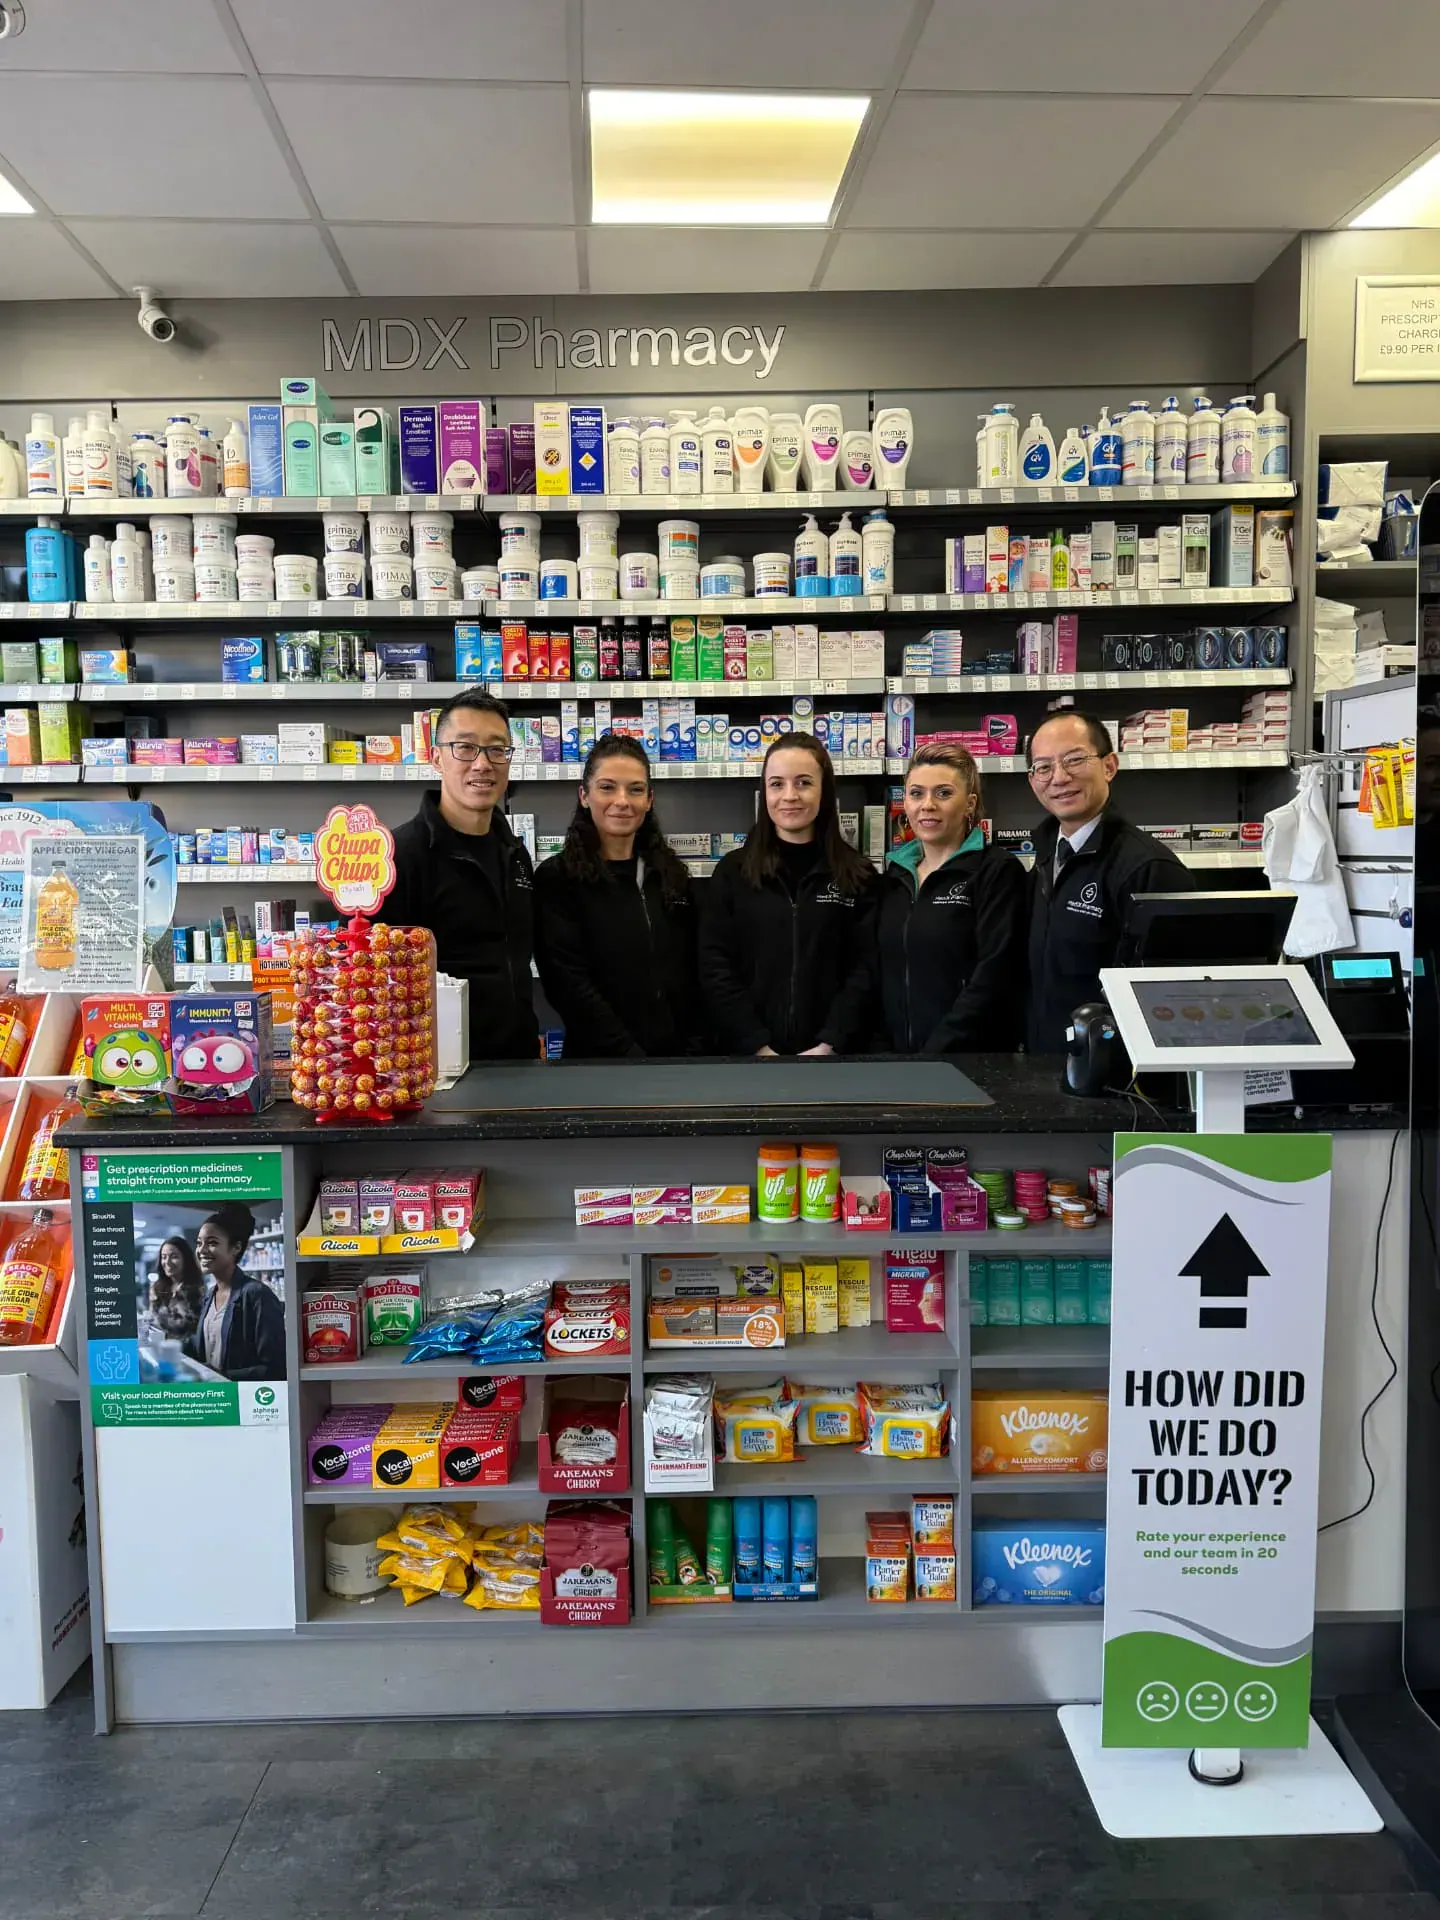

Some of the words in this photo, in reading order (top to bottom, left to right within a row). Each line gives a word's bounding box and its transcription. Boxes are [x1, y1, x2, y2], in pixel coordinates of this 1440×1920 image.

[1411, 299, 1436, 309] NHS
[321, 317, 471, 372] MDX
[489, 316, 787, 379] Pharmacy
[1411, 344, 1434, 353] PER
[223, 642, 254, 653] Nicotinell
[15, 811, 42, 829] 1912
[349, 821, 370, 833] STICK
[997, 830, 1031, 838] PARAMOL
[33, 846, 61, 855] APPLE
[64, 846, 91, 855] CIDER
[95, 846, 137, 855] VINEGAR
[327, 833, 382, 862] Chupa
[325, 857, 380, 883] Chups
[259, 960, 291, 970] HOTHANDS
[110, 1003, 136, 1011] MULTI
[189, 1008, 232, 1017] IMMUNITY
[104, 1012, 143, 1021] VITAMINS
[885, 1149, 924, 1160] ChapStick
[928, 1149, 966, 1160] ChapStick
[106, 1165, 126, 1174] Get
[128, 1165, 189, 1176] prescription
[191, 1164, 243, 1173] medicines
[106, 1175, 147, 1187] straight
[149, 1175, 174, 1184] from
[175, 1177, 198, 1186] your
[199, 1174, 253, 1185] pharmacy
[322, 1184, 354, 1194] Ricola
[361, 1184, 393, 1193] Ricola
[436, 1185, 469, 1195] Ricola
[397, 1190, 428, 1199] Ricola
[320, 1239, 359, 1250] Ricola
[401, 1234, 441, 1248] Ricola
[17, 1289, 39, 1299] CIDER
[373, 1285, 413, 1296] POTTER'S
[308, 1300, 350, 1312] POTTER'S
[752, 1320, 773, 1330] 18%
[551, 1328, 611, 1340] LOCKETS
[468, 1375, 519, 1397] Vocalzone
[1124, 1370, 1224, 1407] HOW
[1233, 1370, 1305, 1407] DID
[102, 1392, 120, 1400] Visit
[121, 1393, 140, 1401] your
[141, 1391, 161, 1399] local
[163, 1391, 205, 1399] Pharmacy
[206, 1390, 225, 1398] First
[1000, 1405, 1090, 1438] Kleenex
[1149, 1419, 1209, 1456] WE
[1219, 1419, 1277, 1457] DO
[318, 1444, 372, 1469] Vocalzone
[383, 1450, 435, 1473] Vocalzone
[451, 1445, 505, 1470] Vocalzone
[1011, 1457, 1043, 1465] ALLERGY
[650, 1462, 687, 1471] FISHERMAN'S
[687, 1462, 707, 1471] FRIEND
[566, 1478, 601, 1489] CHERRY
[1131, 1468, 1293, 1506] TODAY?
[920, 1510, 947, 1521] Barrier
[1136, 1531, 1170, 1542] Rate
[1173, 1533, 1206, 1545] your
[1208, 1532, 1287, 1545] experience
[1003, 1537, 1092, 1570] Kleenex
[1143, 1548, 1172, 1559] and
[1174, 1549, 1199, 1558] our
[1201, 1548, 1238, 1558] team
[1241, 1547, 1254, 1558] in
[1257, 1547, 1278, 1558] 20
[874, 1564, 902, 1577] Barrier
[923, 1563, 950, 1575] Barrier
[1181, 1564, 1239, 1575] seconds
[880, 1575, 898, 1583] Balm
[568, 1611, 602, 1621] CHERRY
